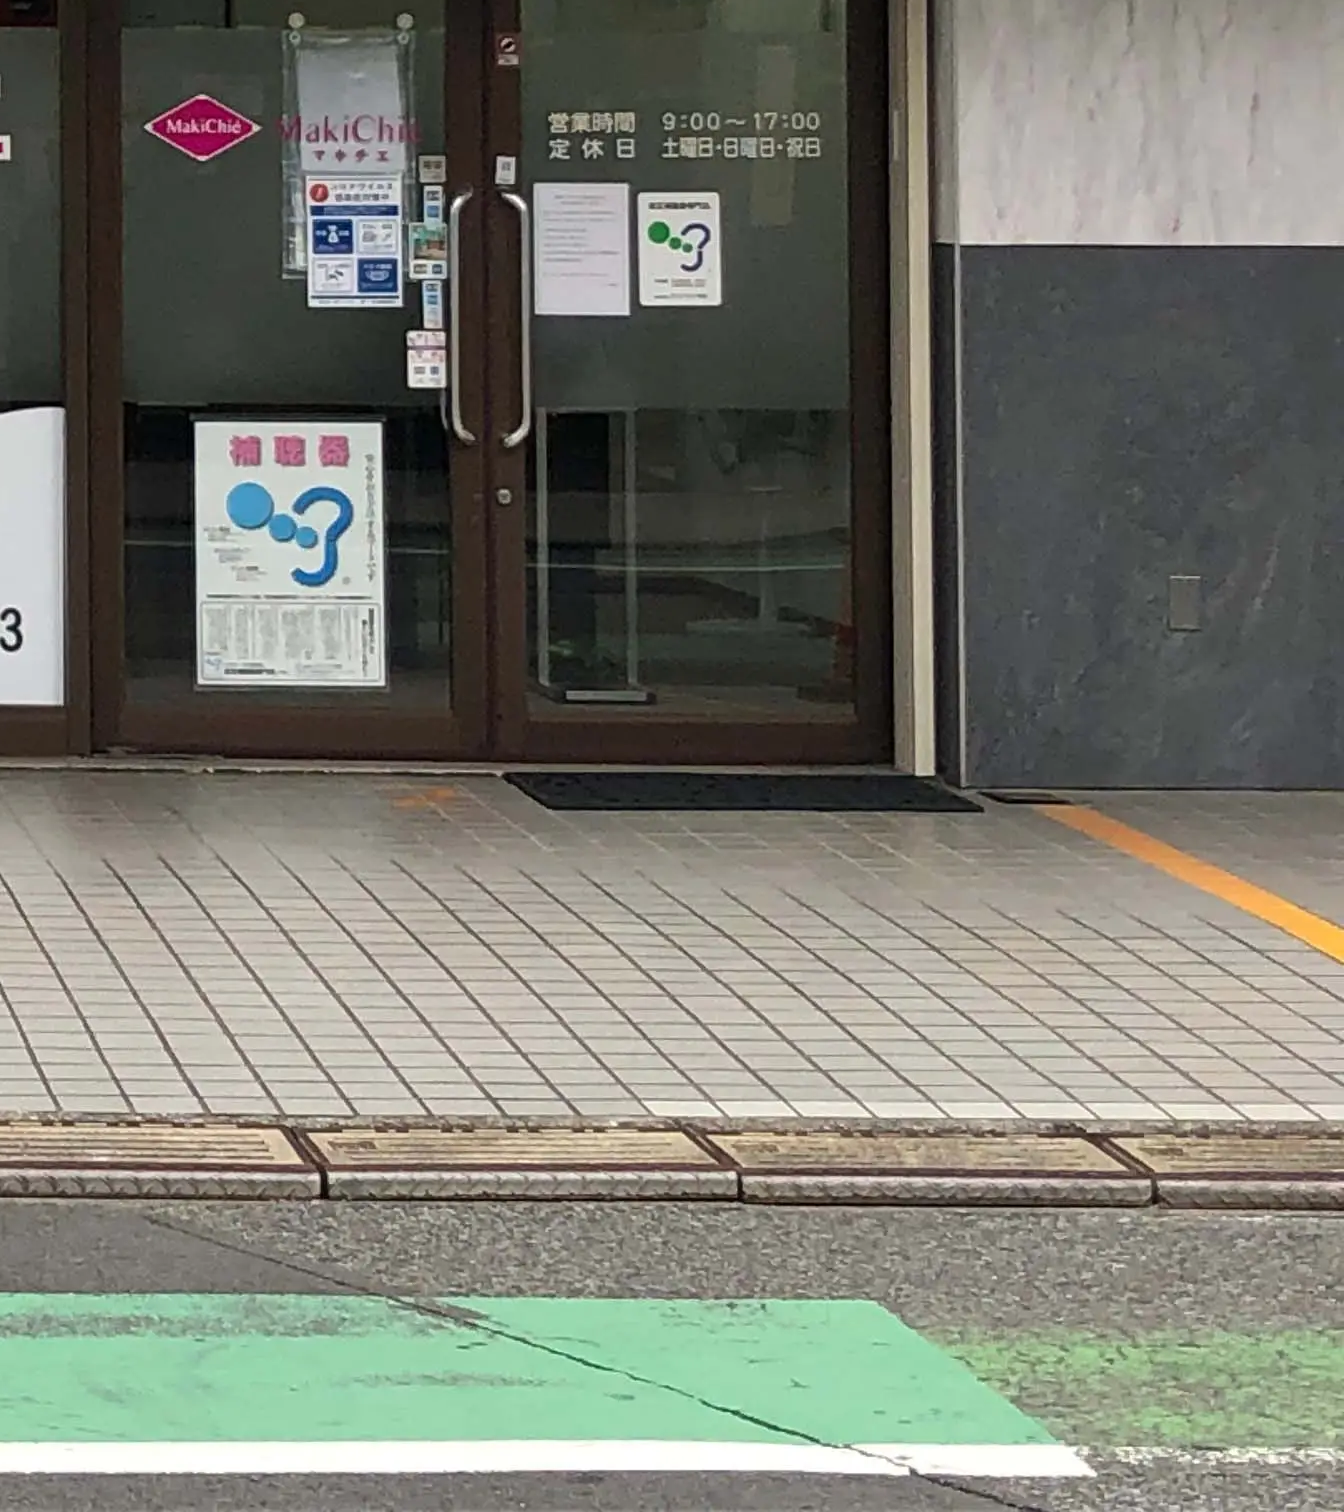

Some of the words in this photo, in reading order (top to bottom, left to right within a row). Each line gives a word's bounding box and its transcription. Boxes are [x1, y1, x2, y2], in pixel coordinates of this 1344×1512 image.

[548, 112, 636, 133] 営業時間
[548, 138, 636, 159] 定休日
[229, 435, 350, 467] 補聴器
